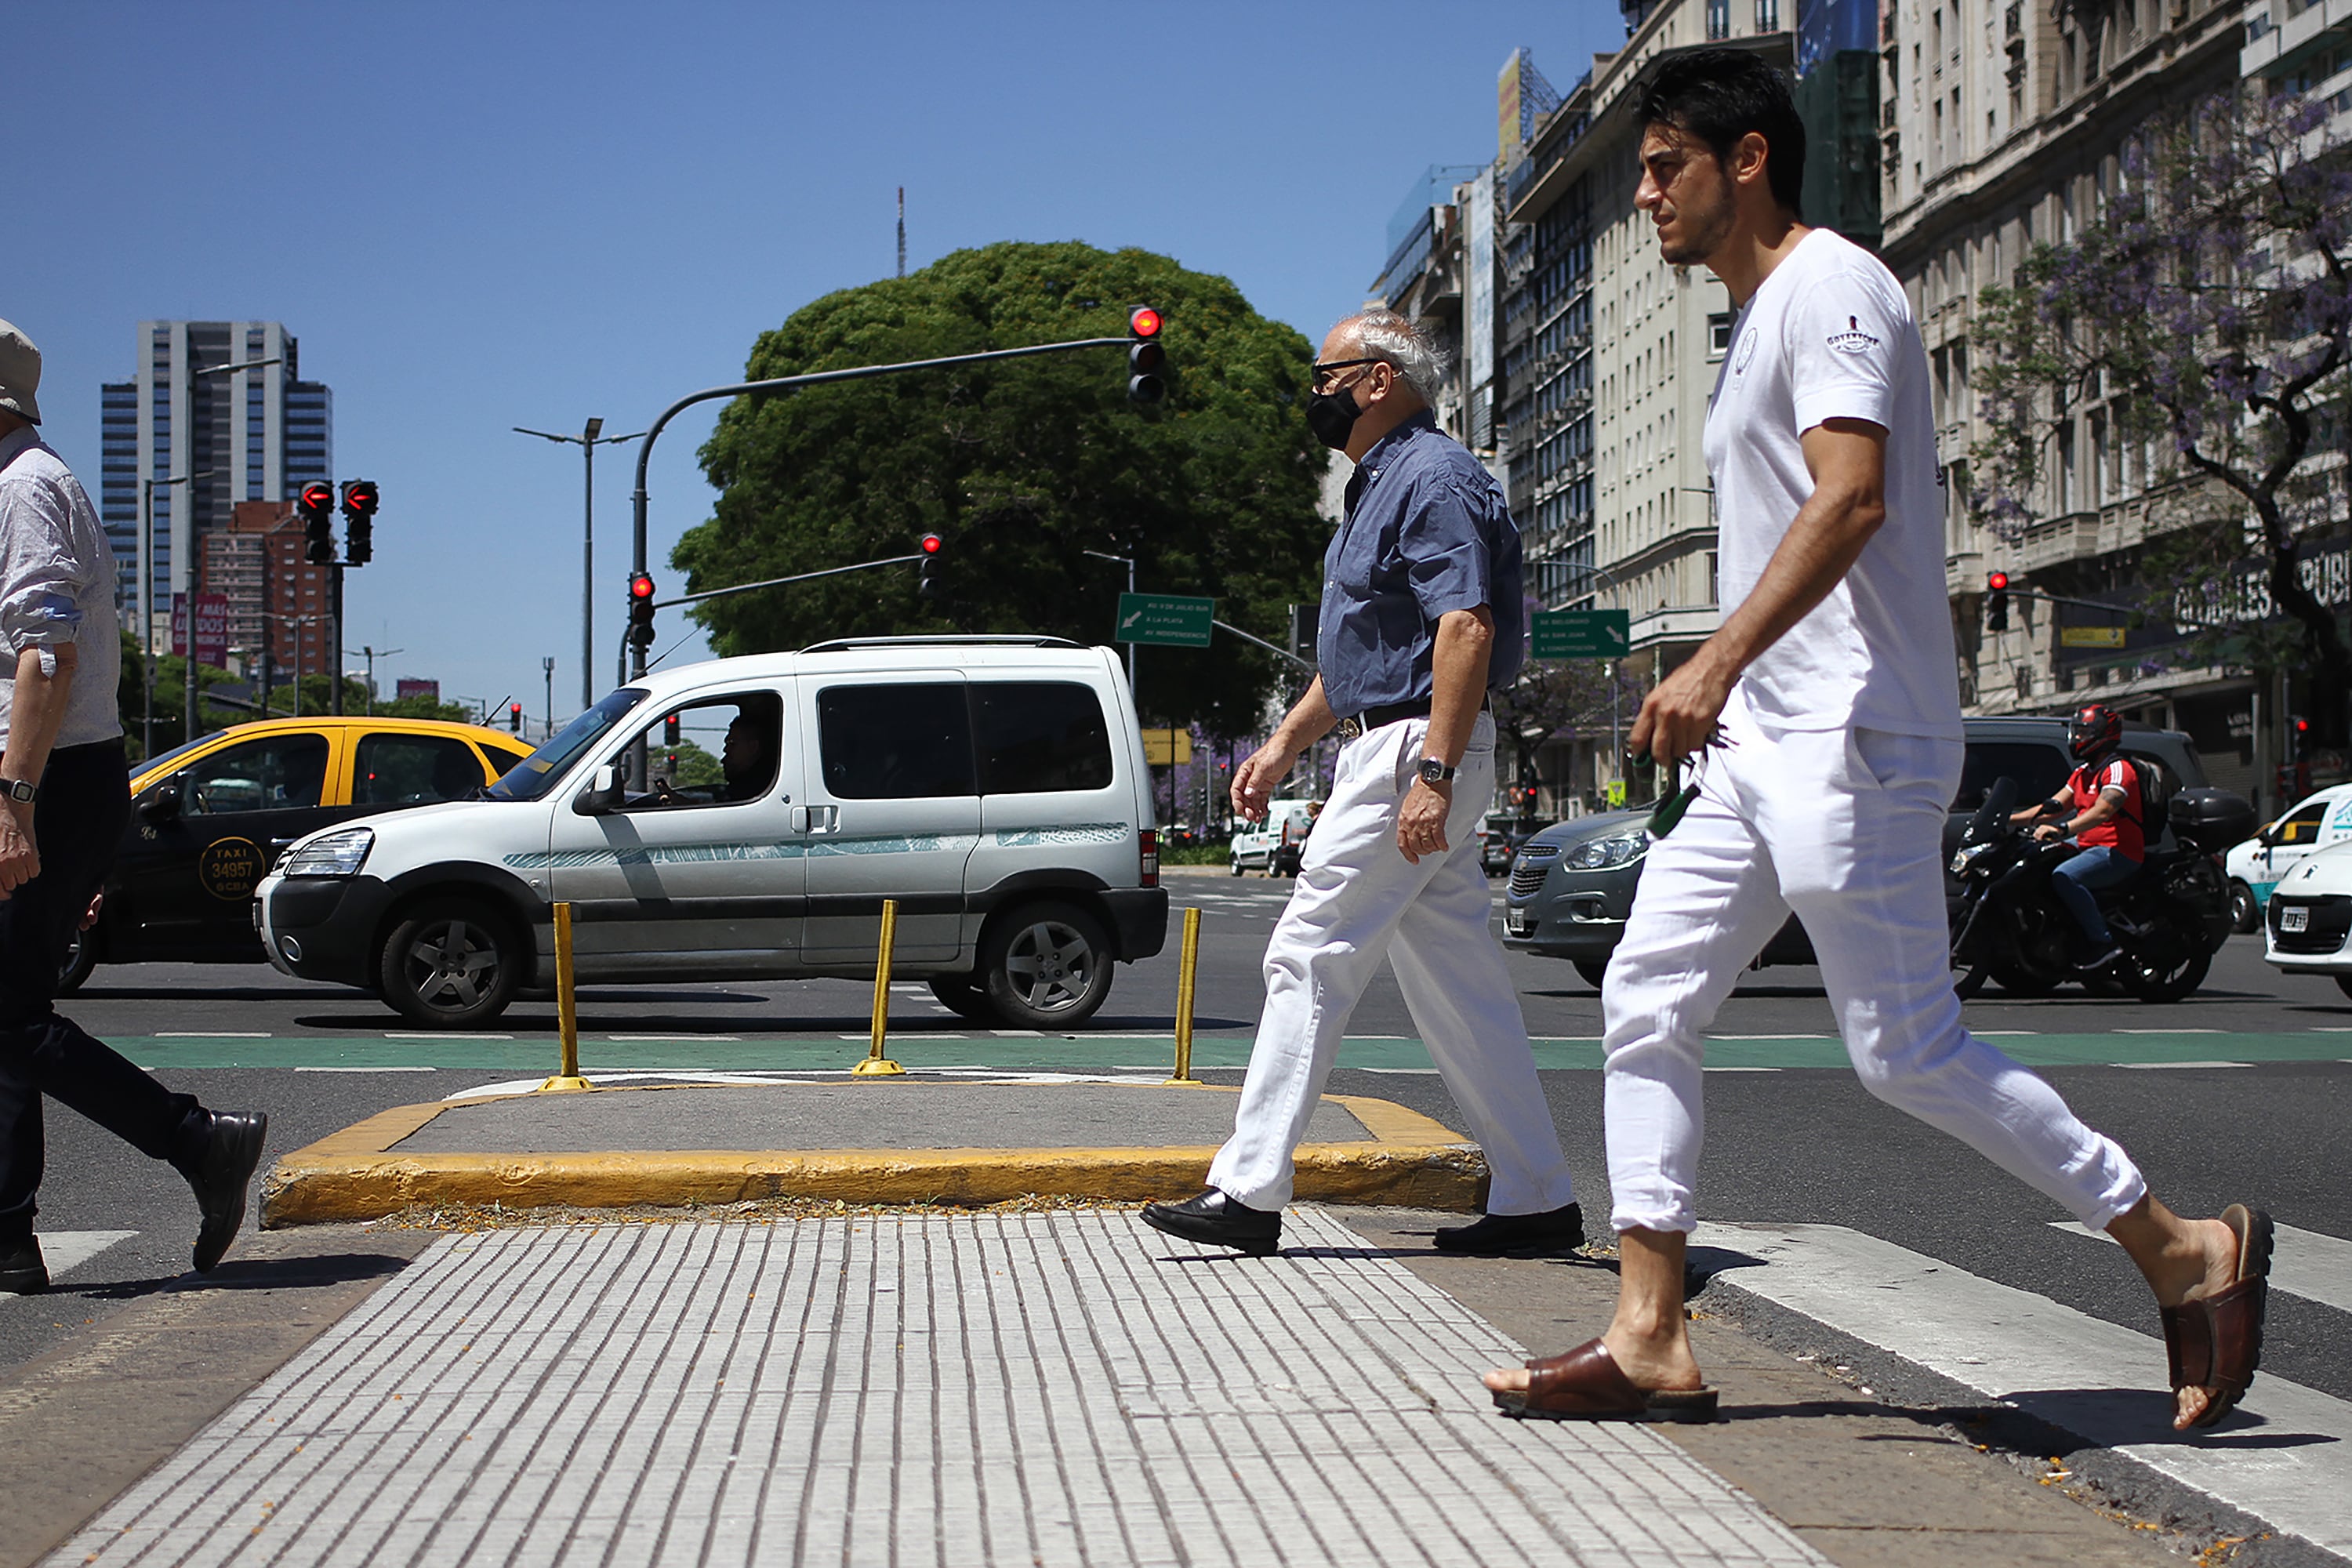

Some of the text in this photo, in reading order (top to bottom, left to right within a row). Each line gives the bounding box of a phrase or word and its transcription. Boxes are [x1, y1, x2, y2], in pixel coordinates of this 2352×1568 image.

[175, 616, 225, 633] UDOS
[215, 848, 247, 858] TAXI
[212, 862, 252, 878] 34957
